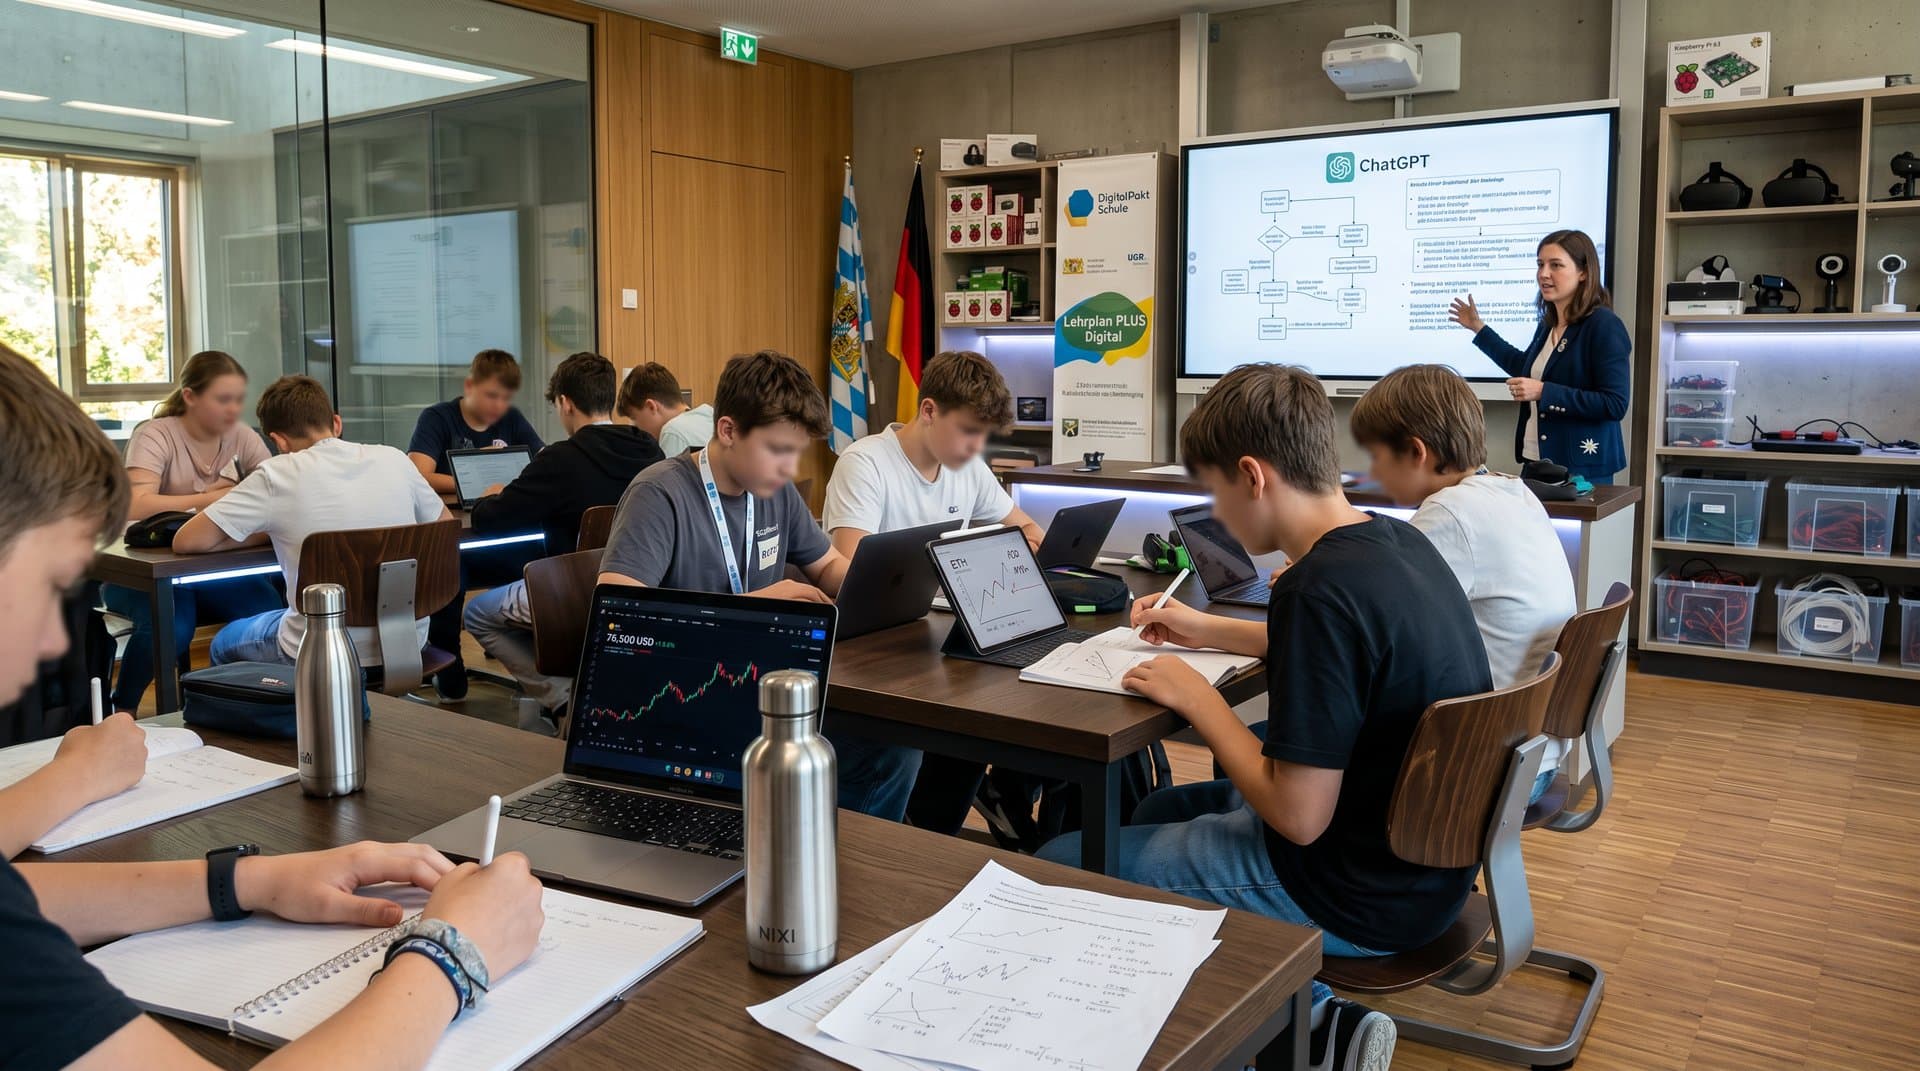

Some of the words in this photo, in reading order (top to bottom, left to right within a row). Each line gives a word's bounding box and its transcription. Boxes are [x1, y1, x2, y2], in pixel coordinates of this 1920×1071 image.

[1360, 154, 1430, 172] ChatGPT
[1098, 203, 1129, 214] Schule
[1127, 253, 1144, 261] UGR
[1063, 315, 1113, 329] Lehrplan
[1116, 315, 1146, 327] PLUS
[1085, 330, 1122, 345] Digital
[950, 558, 968, 570] ETH
[606, 633, 635, 644] 76,500
[636, 636, 654, 647] USD
[759, 926, 795, 944] NIXI
